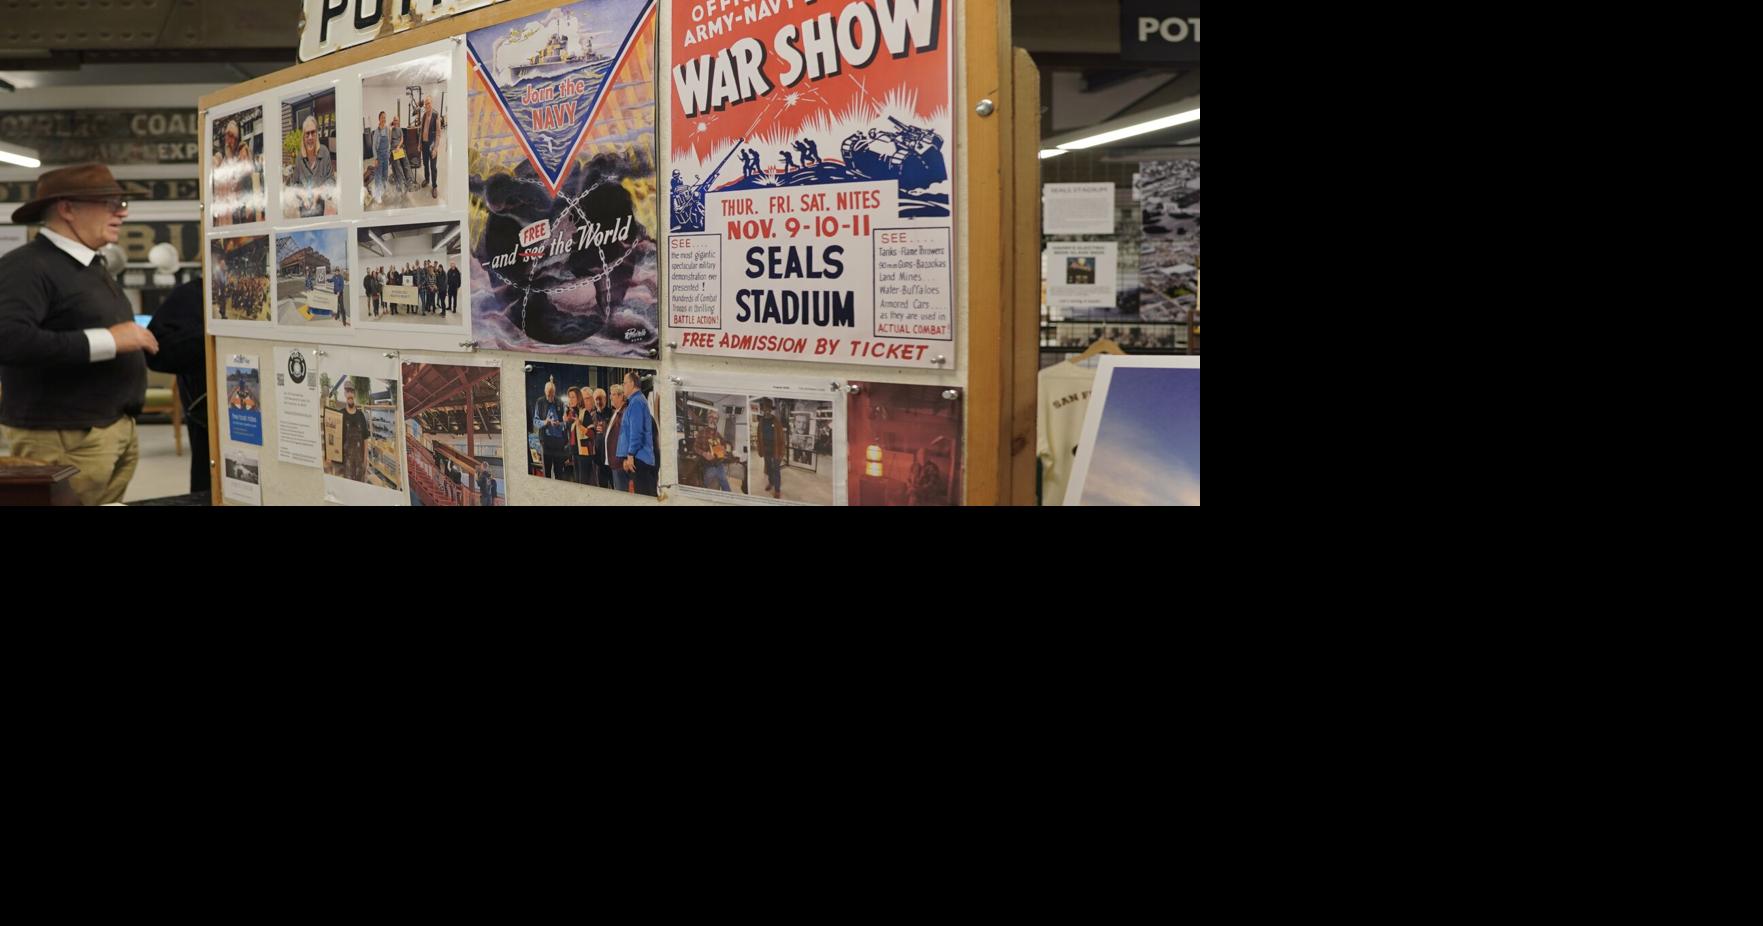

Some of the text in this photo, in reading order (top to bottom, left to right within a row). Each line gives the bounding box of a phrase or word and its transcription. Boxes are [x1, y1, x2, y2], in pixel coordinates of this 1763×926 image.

[673, 0, 942, 119] WAR SHOW
[559, 79, 585, 97] the
[532, 100, 578, 132] NAVY
[721, 190, 881, 217] THUR. FRI. SAT. NITES
[523, 222, 547, 245] FREE
[550, 231, 573, 257] the
[576, 214, 633, 251] World
[727, 214, 871, 241] NOV. 9-10-11
[745, 244, 845, 280] SEALS
[879, 272, 896, 281] Land
[673, 314, 696, 325] BATTLE
[735, 288, 855, 328] STADIUM
[877, 323, 911, 334] ACTUAL
[681, 331, 929, 361] FREE ADMISSION BY TICKET
[1052, 393, 1079, 410] SAN
